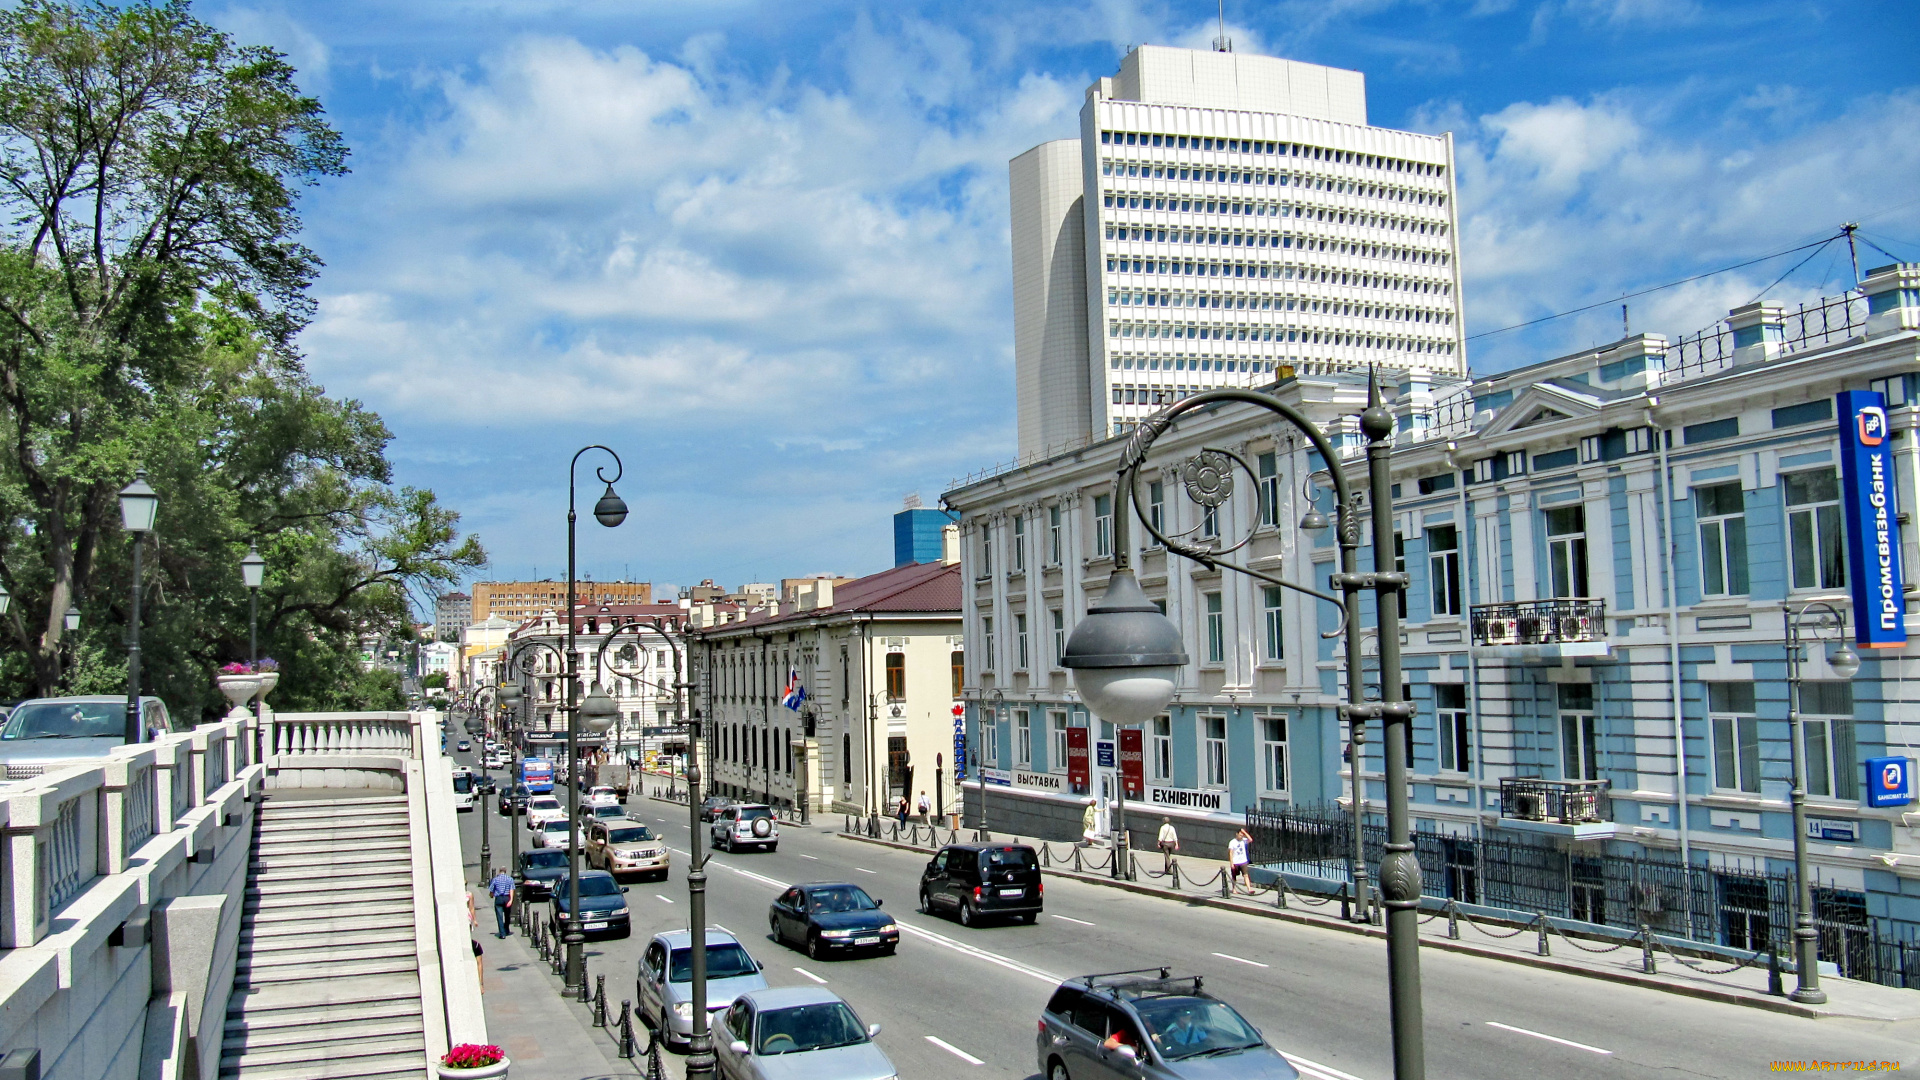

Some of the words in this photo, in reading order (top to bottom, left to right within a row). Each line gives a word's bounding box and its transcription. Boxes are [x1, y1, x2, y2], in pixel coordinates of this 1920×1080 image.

[1870, 453, 1898, 629] Промсвязьбанк
[1017, 773, 1060, 789] ВЫСТАВКА
[1152, 788, 1220, 809] EXHIBITION
[1877, 793, 1902, 801] БАНКОМАТ
[1809, 822, 1819, 833] 14
